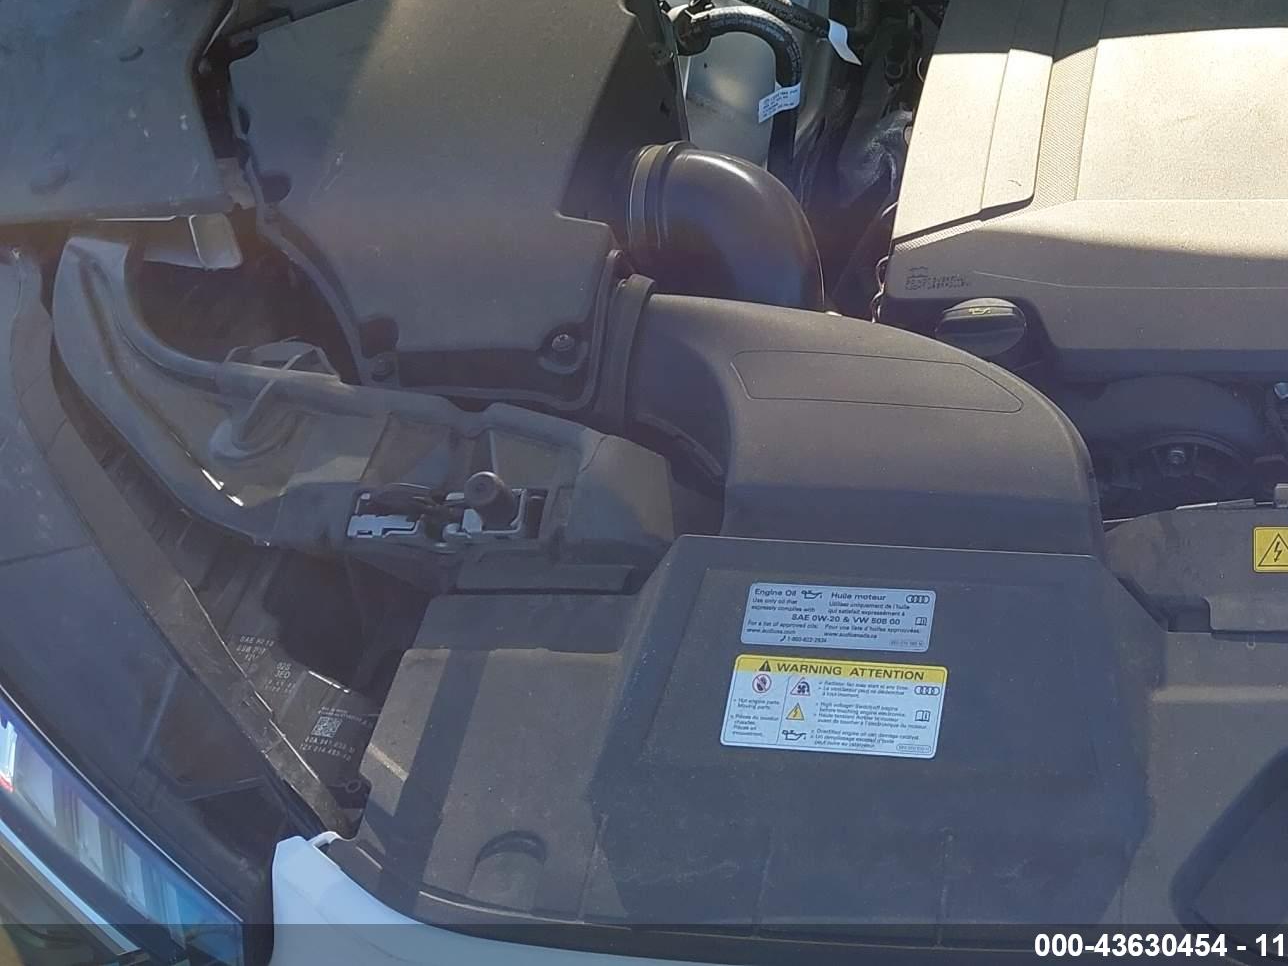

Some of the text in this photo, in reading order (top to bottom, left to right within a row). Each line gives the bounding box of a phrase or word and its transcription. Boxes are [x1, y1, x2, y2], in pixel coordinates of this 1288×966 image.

[754, 588, 797, 597] Engine Oil
[831, 592, 852, 600] Huile
[791, 613, 810, 621] SAE
[811, 614, 840, 623] 0W-20
[852, 616, 870, 624] VW
[871, 617, 888, 625] 508
[776, 662, 925, 681] WARNING ATTENTION
